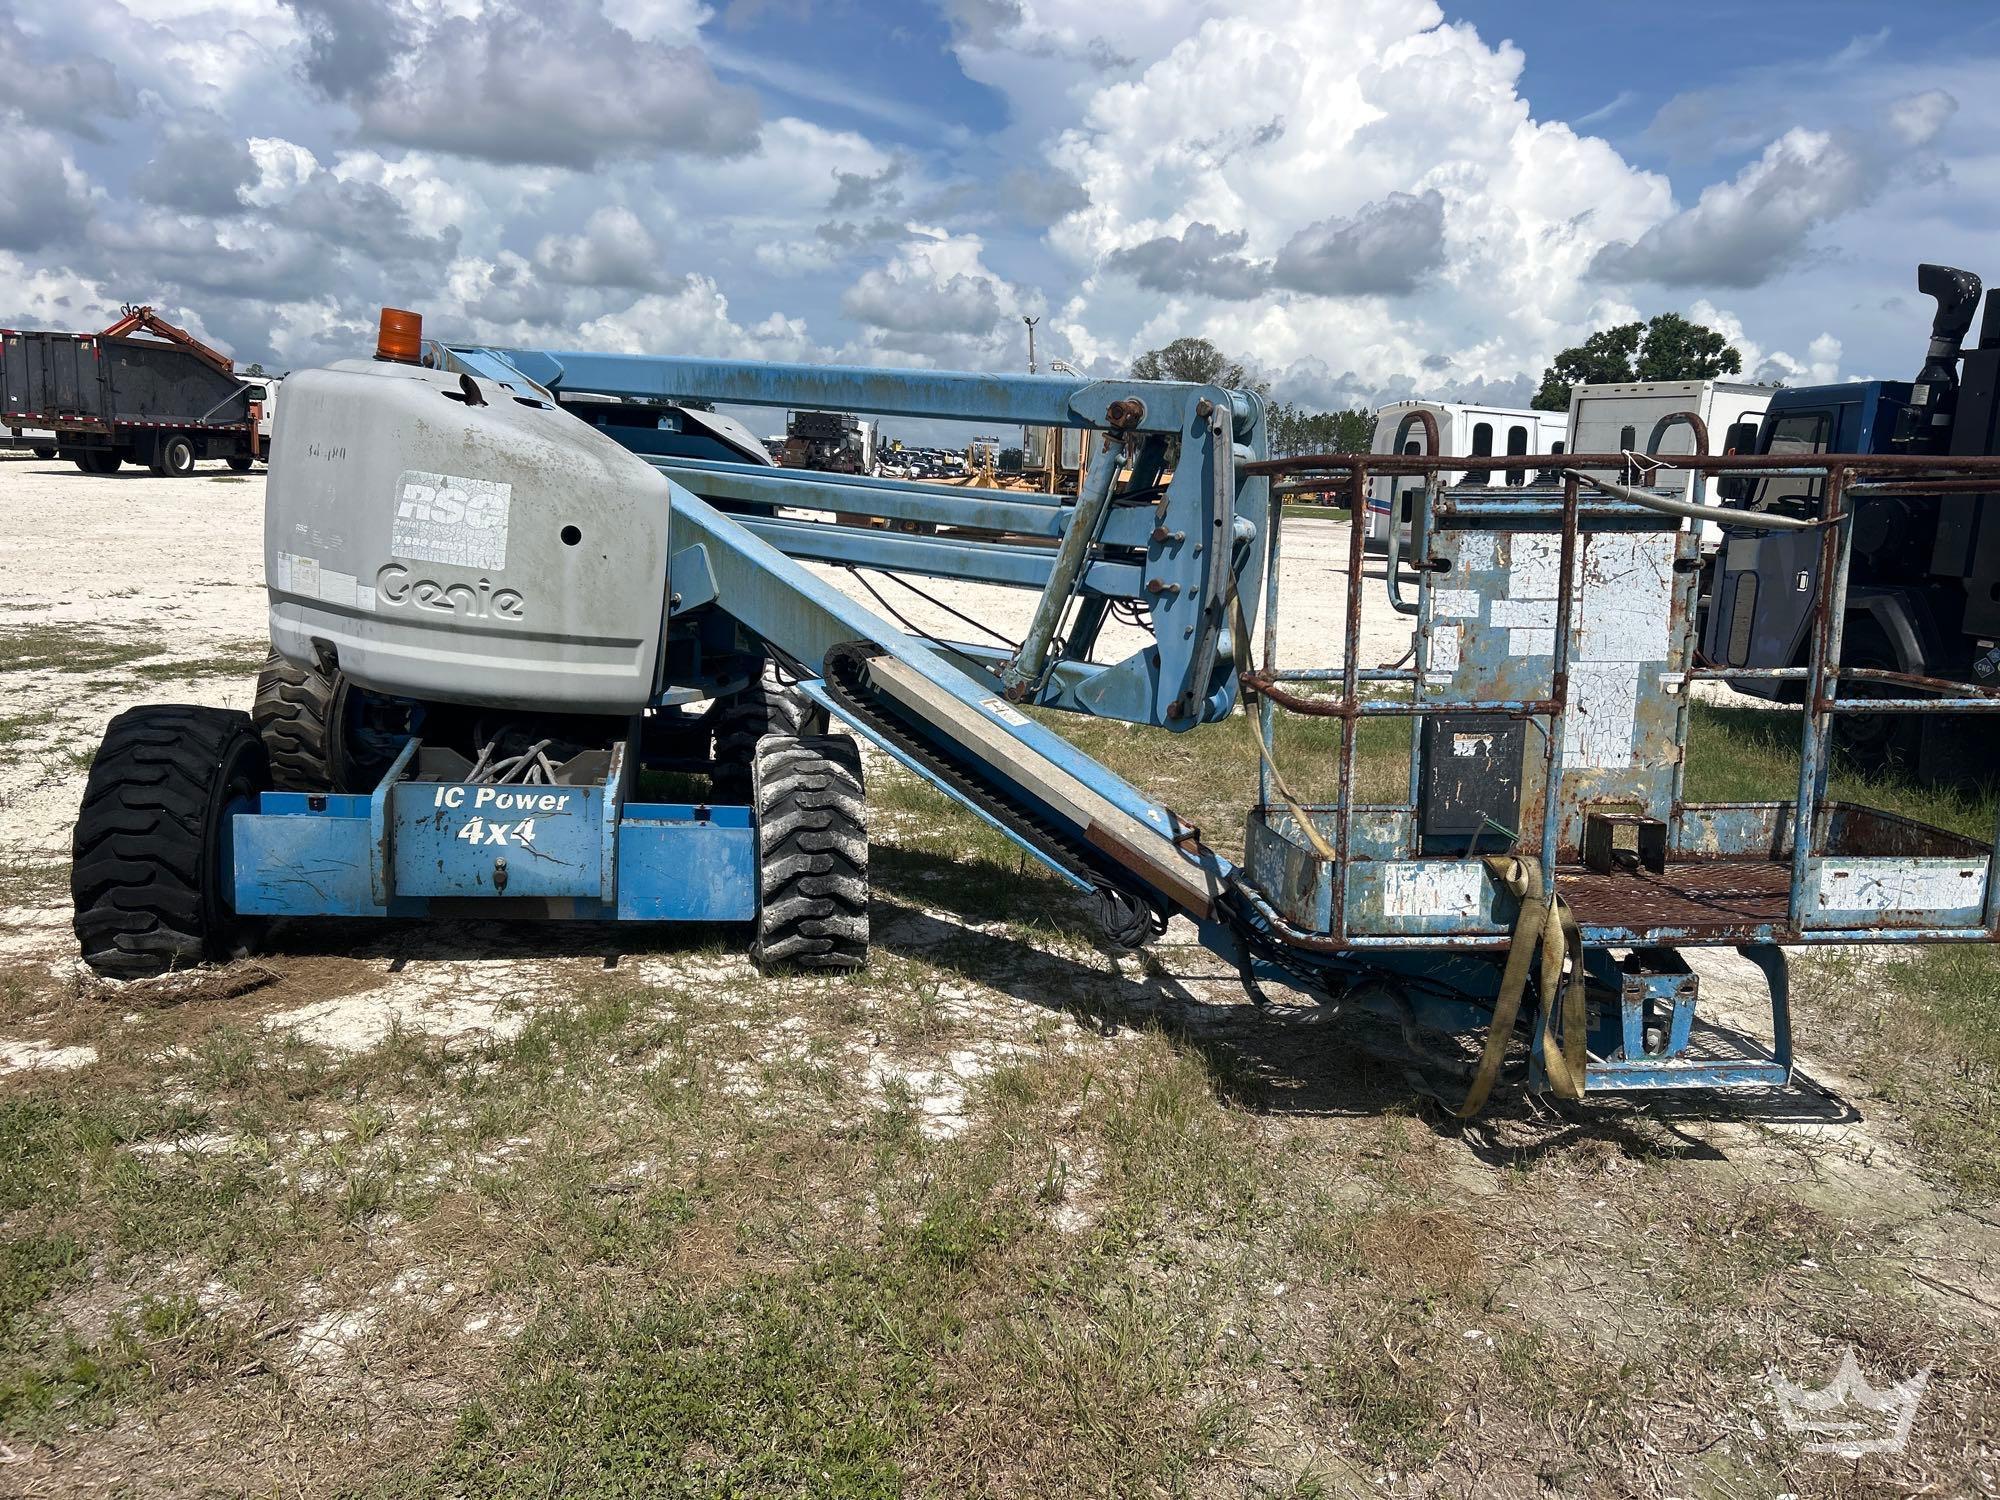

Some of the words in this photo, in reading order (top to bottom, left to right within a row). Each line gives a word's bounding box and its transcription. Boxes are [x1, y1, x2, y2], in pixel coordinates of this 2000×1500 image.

[397, 484, 505, 529] RSC
[377, 563, 524, 620] Genie
[1977, 663, 1991, 673] CNG
[434, 786, 465, 808] IC
[474, 787, 570, 811] Power
[457, 816, 536, 846] 4x4
